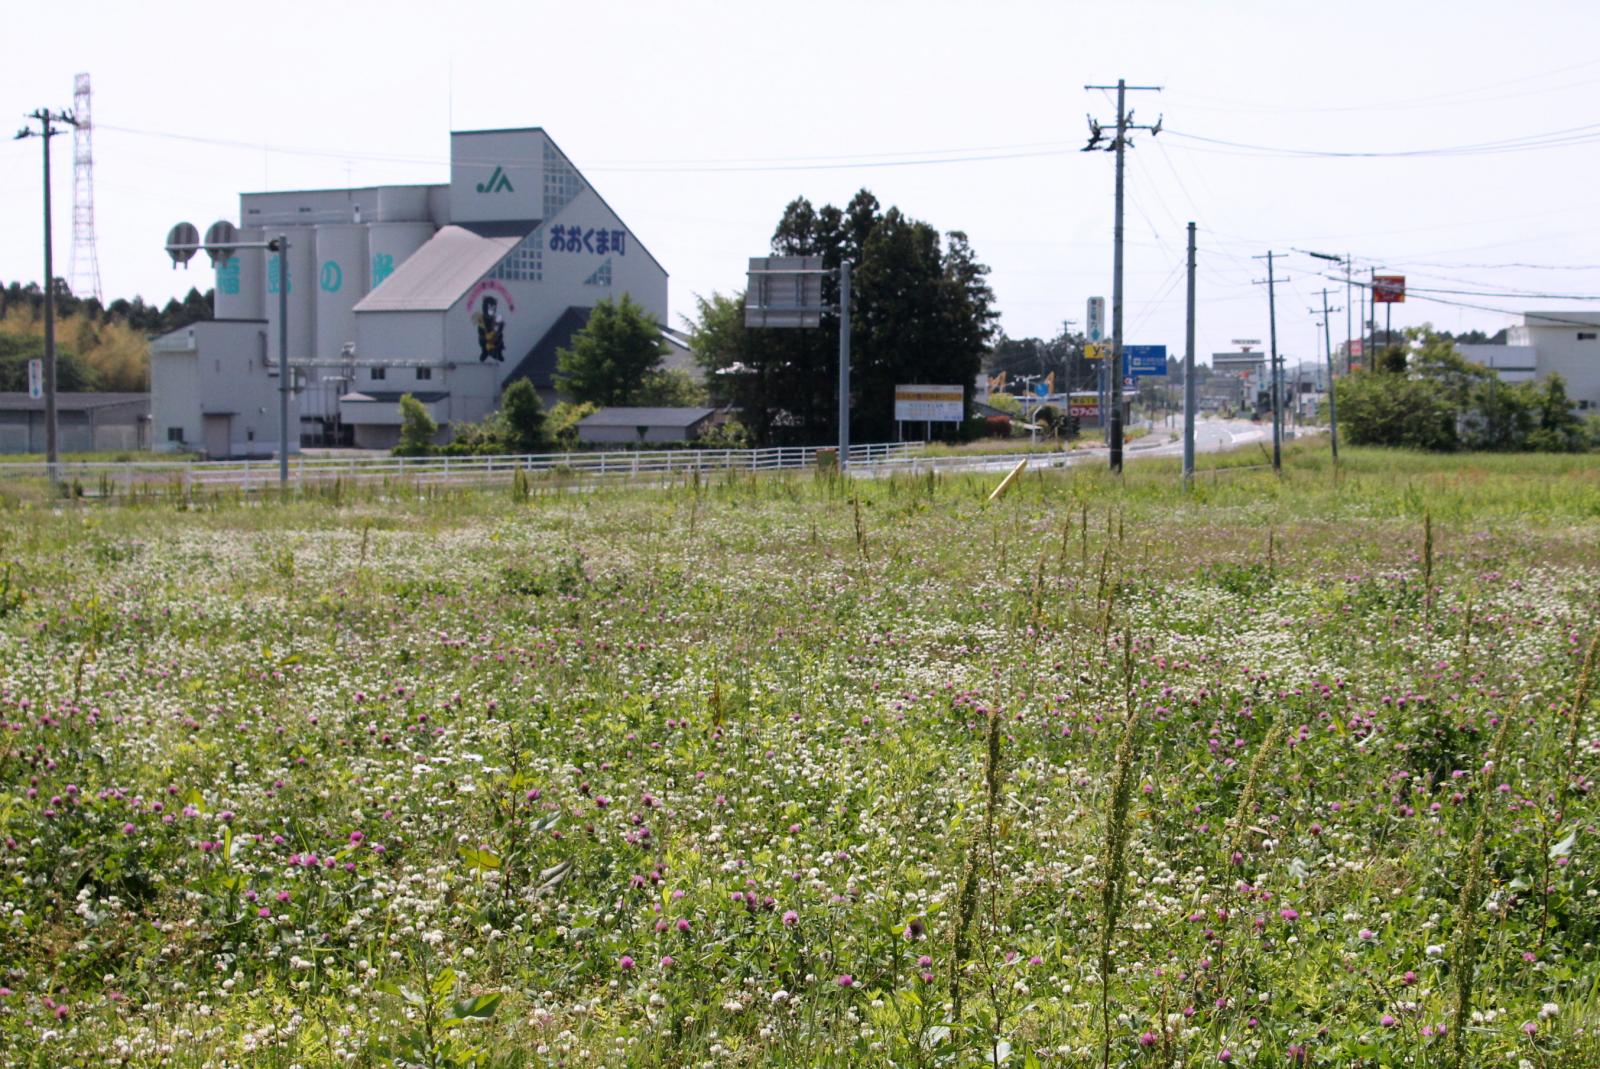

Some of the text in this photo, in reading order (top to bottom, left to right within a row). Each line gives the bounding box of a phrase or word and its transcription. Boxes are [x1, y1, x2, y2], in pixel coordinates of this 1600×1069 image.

[549, 224, 626, 256] おおくま町
